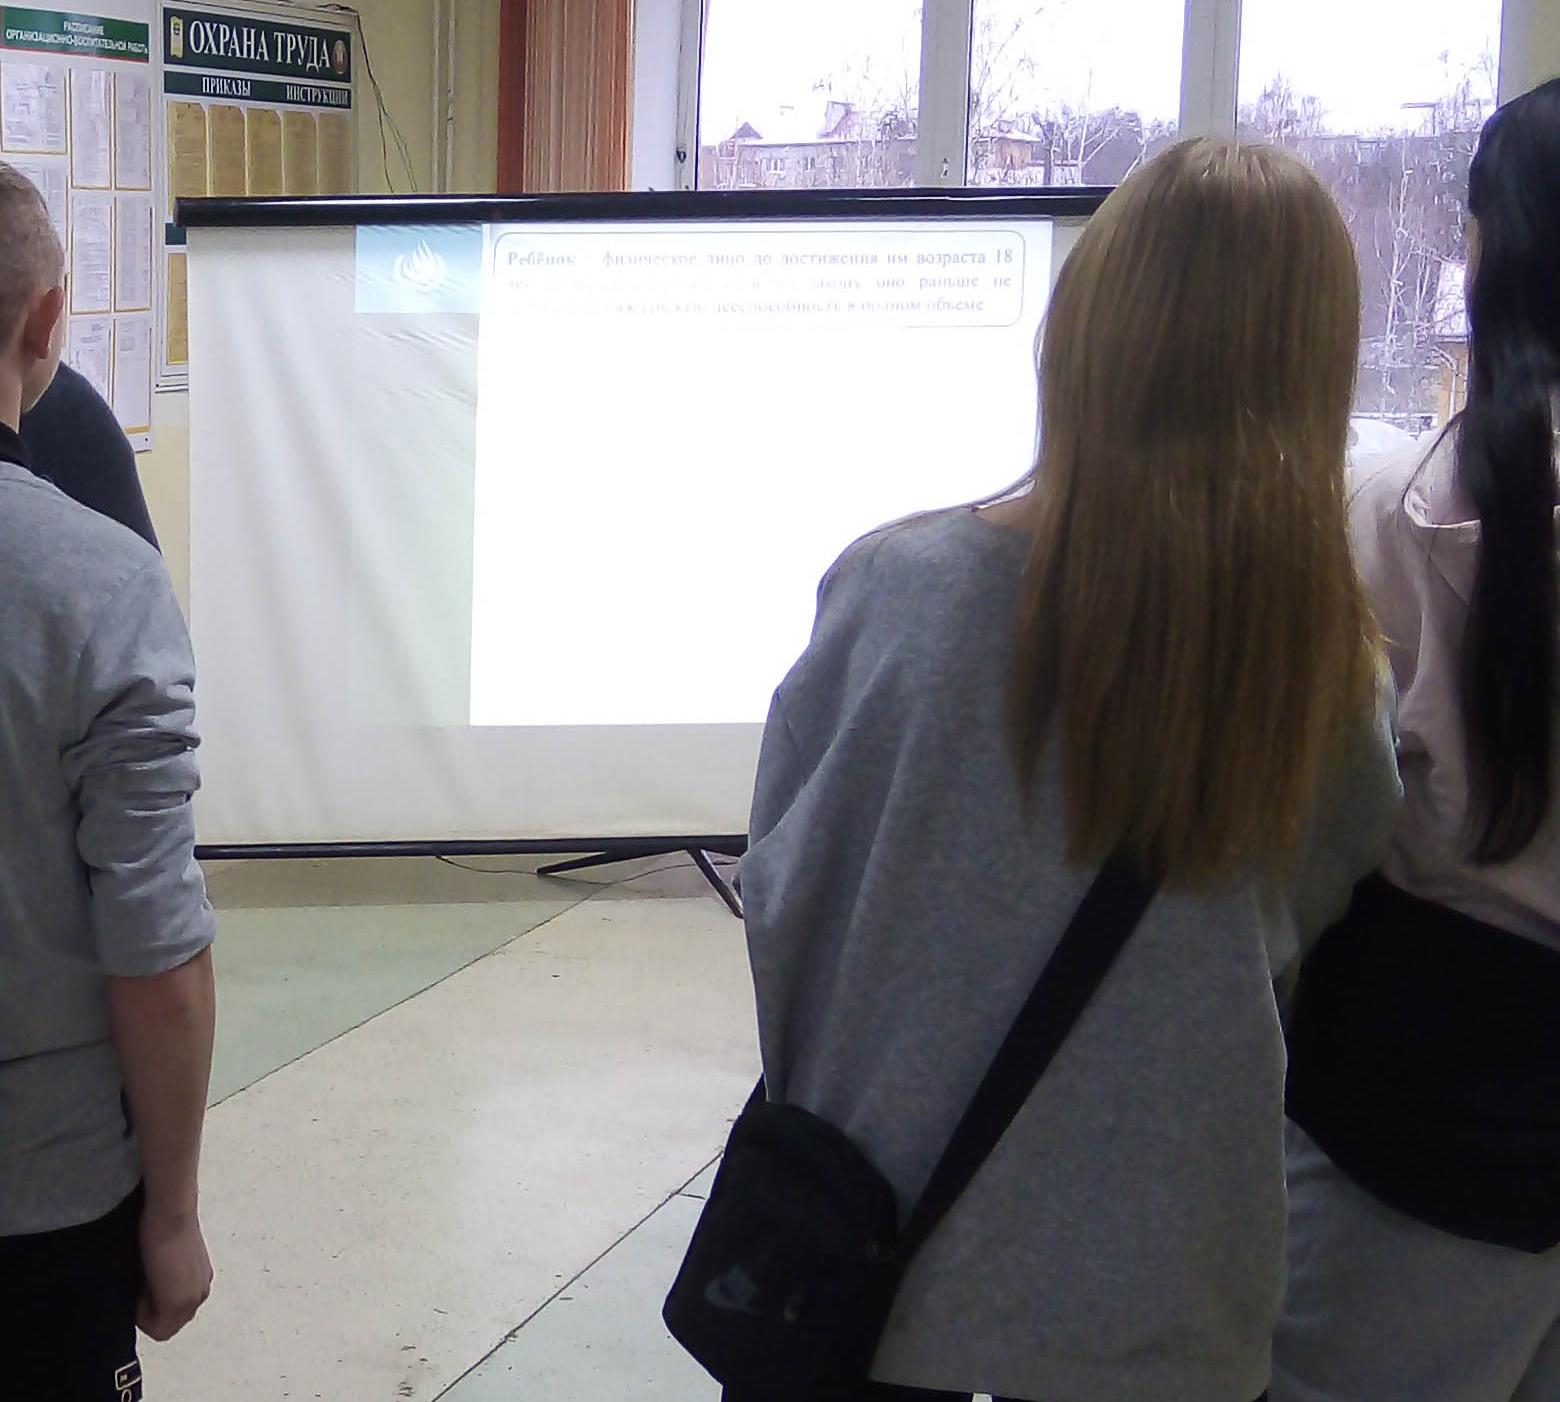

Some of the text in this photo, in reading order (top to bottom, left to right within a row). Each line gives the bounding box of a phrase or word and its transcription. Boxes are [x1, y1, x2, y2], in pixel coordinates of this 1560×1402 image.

[189, 20, 332, 73] ОХРАНА ТРУДА
[202, 76, 251, 96] ПРИКАЗЫ
[286, 84, 348, 106] ИНСТРУКЦИИ
[888, 253, 908, 266] им
[916, 251, 987, 269] возраста
[996, 248, 1014, 265] 18
[920, 277, 980, 291] раньше
[993, 277, 1012, 288] не
